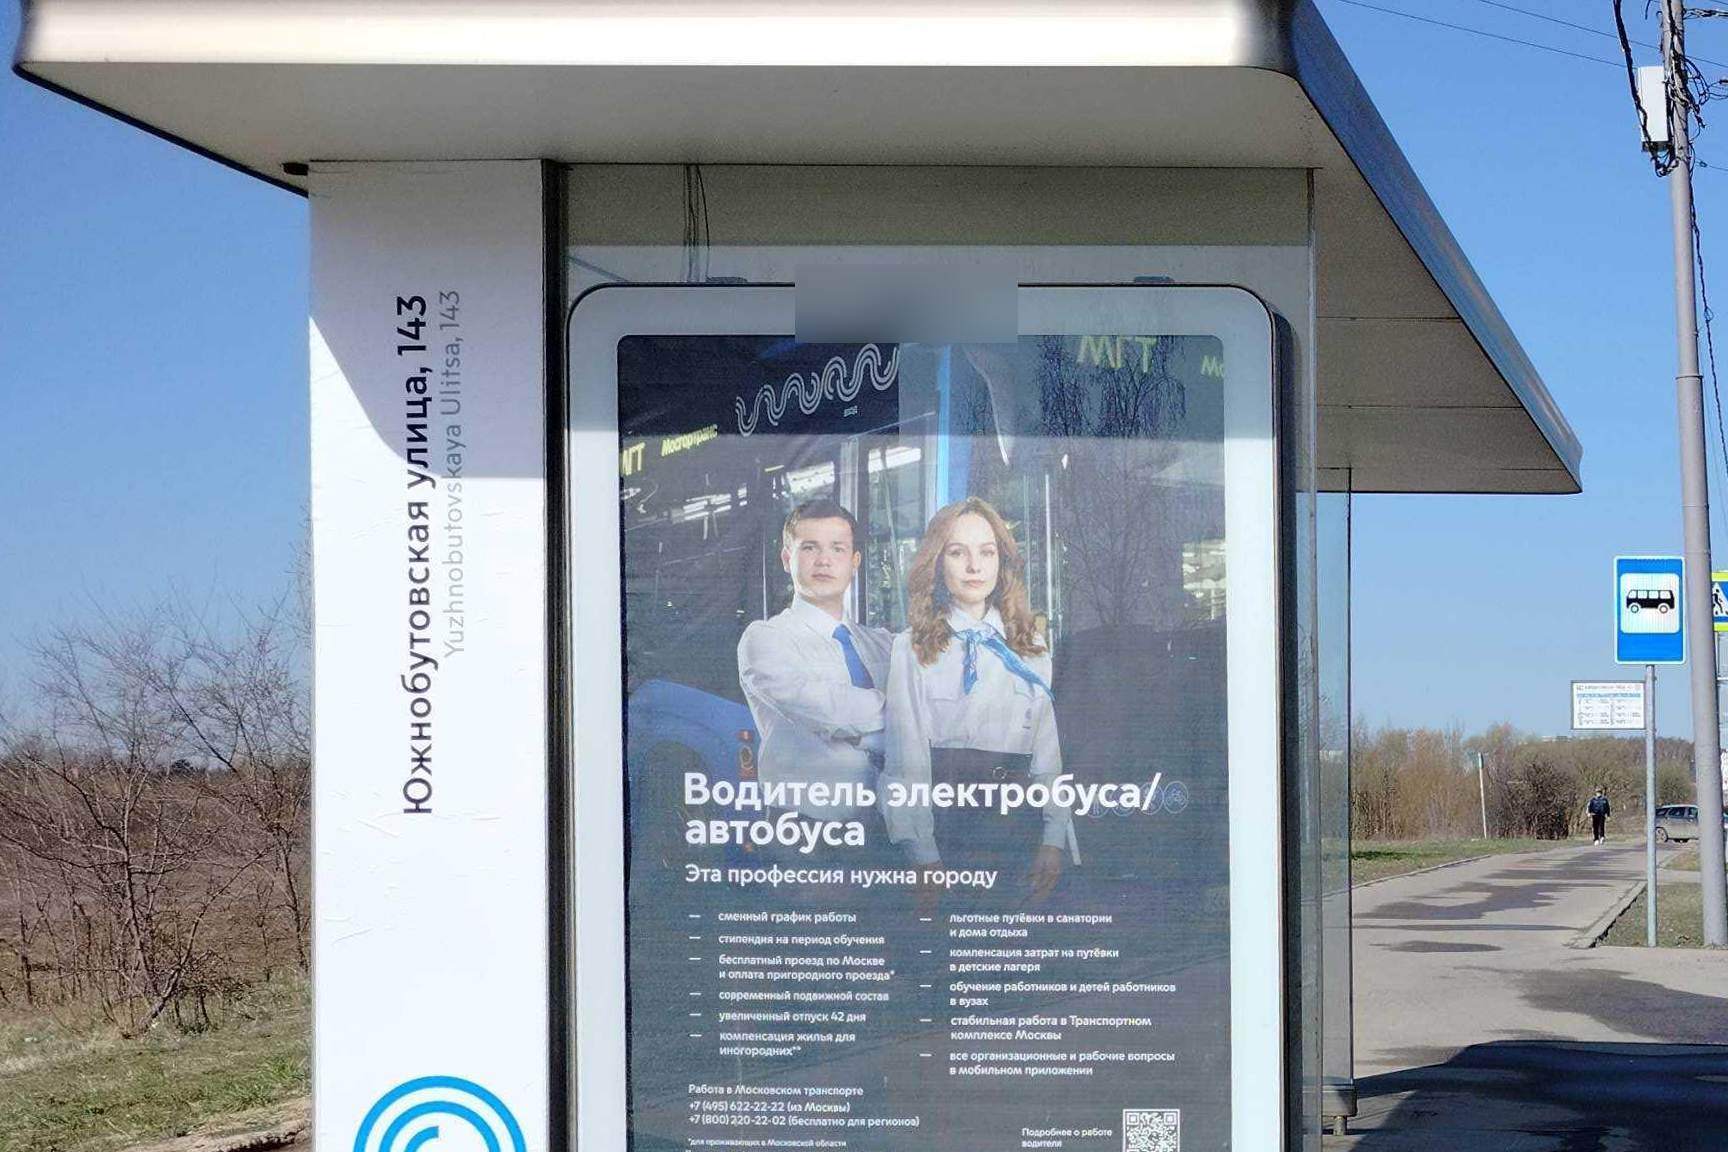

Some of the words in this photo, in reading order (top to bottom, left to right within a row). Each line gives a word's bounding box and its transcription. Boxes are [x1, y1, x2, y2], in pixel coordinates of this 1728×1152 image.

[440, 290, 460, 332] 143
[397, 295, 427, 355] 143
[442, 335, 464, 414] Ulitsa,
[405, 367, 436, 488] улица,
[443, 424, 467, 658] Yuzhnobutovskaya
[399, 501, 438, 814] Южнобутовская
[684, 773, 876, 812] Водитель
[886, 772, 1161, 815] электробуса/
[685, 814, 866, 853] автобуса
[685, 865, 722, 883] Эта
[728, 864, 844, 888] профессия
[850, 869, 917, 888] нужна
[923, 870, 997, 889] городу
[719, 912, 768, 922] сменный
[771, 912, 811, 924] график
[815, 913, 856, 924] работы
[950, 914, 999, 924] льготные
[1003, 913, 1045, 925] путёвки
[1056, 914, 1112, 923] санатории
[950, 929, 956, 937] и
[959, 929, 987, 938] дома
[989, 928, 1027, 938] отдыха
[719, 936, 773, 945] стипендия
[776, 936, 789, 944] на
[792, 936, 831, 946] период
[834, 935, 884, 946] обучения
[950, 949, 1022, 959] компенсация
[1024, 949, 1059, 959] затрат
[1062, 949, 1074, 957] на
[1077, 947, 1119, 959] путёвки
[719, 954, 781, 965] бесплатный
[785, 957, 824, 966] проезд
[827, 957, 839, 965] по
[842, 956, 885, 965] Москве
[950, 963, 956, 971] в
[958, 963, 1001, 973] детские
[1004, 963, 1040, 973] лагеря
[729, 971, 764, 979] оплата
[767, 971, 843, 981] пригородного
[950, 982, 1001, 993] обучение
[1004, 982, 1067, 993] работников
[1079, 982, 1110, 993] детей
[1112, 983, 1176, 993] работников
[719, 991, 790, 1002] современный
[793, 991, 852, 1001] подвижной
[855, 993, 889, 1001] состав
[959, 998, 988, 1007] вузах
[719, 1012, 789, 1023] увеличенный
[792, 1013, 828, 1023] отпуск
[831, 1013, 844, 1021] 42
[846, 1014, 866, 1023] дня
[951, 1016, 1015, 1026] стабильная
[1019, 1016, 1057, 1028] работа
[1061, 1017, 1067, 1025] в
[1070, 1016, 1151, 1027] Транспортном
[720, 1033, 794, 1043] компенсация
[797, 1033, 832, 1042] жилья
[835, 1033, 855, 1043] для
[951, 1032, 1012, 1041] комплексе
[1015, 1031, 1061, 1040] Москвы
[950, 1053, 968, 1061] все
[971, 1053, 1066, 1063] организационные
[1080, 1051, 1125, 1063] рабочие
[1128, 1053, 1175, 1063] вопросы
[950, 1067, 956, 1075] в
[959, 1065, 1022, 1075] мобильном
[1025, 1067, 1092, 1076] приложении
[689, 1085, 724, 1095] Работа
[735, 1085, 801, 1095] Московском
[804, 1087, 863, 1096] транспорте
[689, 1101, 700, 1110] +7
[703, 1101, 729, 1111] (495)
[730, 1102, 784, 1111] 622-22-22
[788, 1103, 802, 1112] (из
[804, 1103, 850, 1113] Москвы)
[689, 1115, 700, 1124] +7
[702, 1115, 729, 1125] (800)
[731, 1116, 786, 1126] 220-22-02
[789, 1116, 845, 1126] (бесплатно
[848, 1118, 865, 1127] для
[868, 1117, 919, 1128] регионов)
[1022, 1128, 1072, 1138] Подробнее
[1082, 1128, 1112, 1137] работе
[1022, 1140, 1062, 1148] водителя
